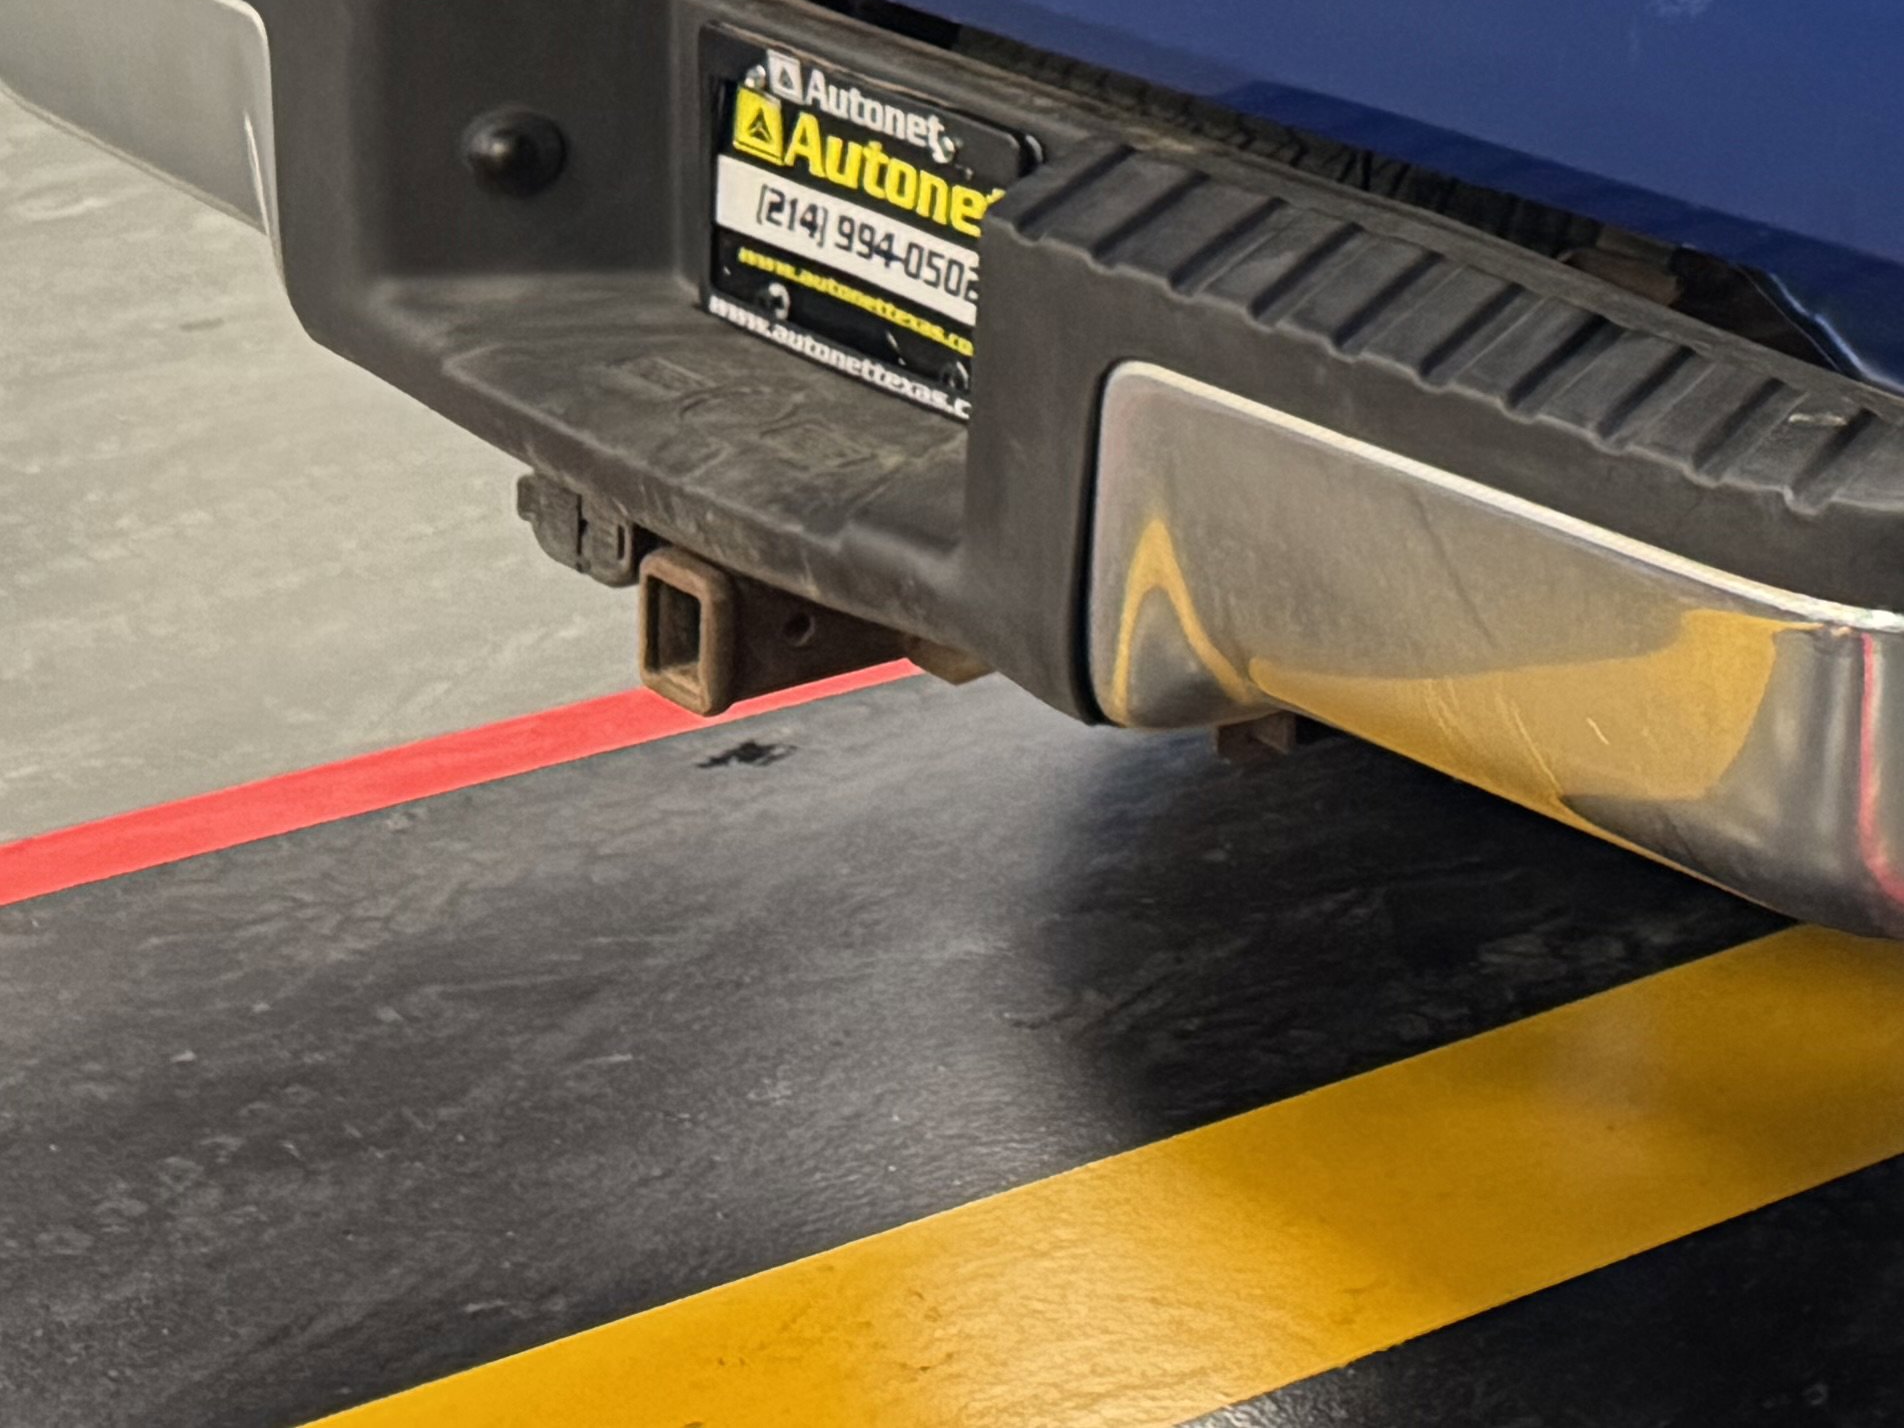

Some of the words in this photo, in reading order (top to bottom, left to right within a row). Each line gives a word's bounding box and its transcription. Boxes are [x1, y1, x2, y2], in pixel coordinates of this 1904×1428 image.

[806, 67, 946, 154] Autonet
[756, 183, 829, 249] (214)
[784, 111, 1006, 238] Autone
